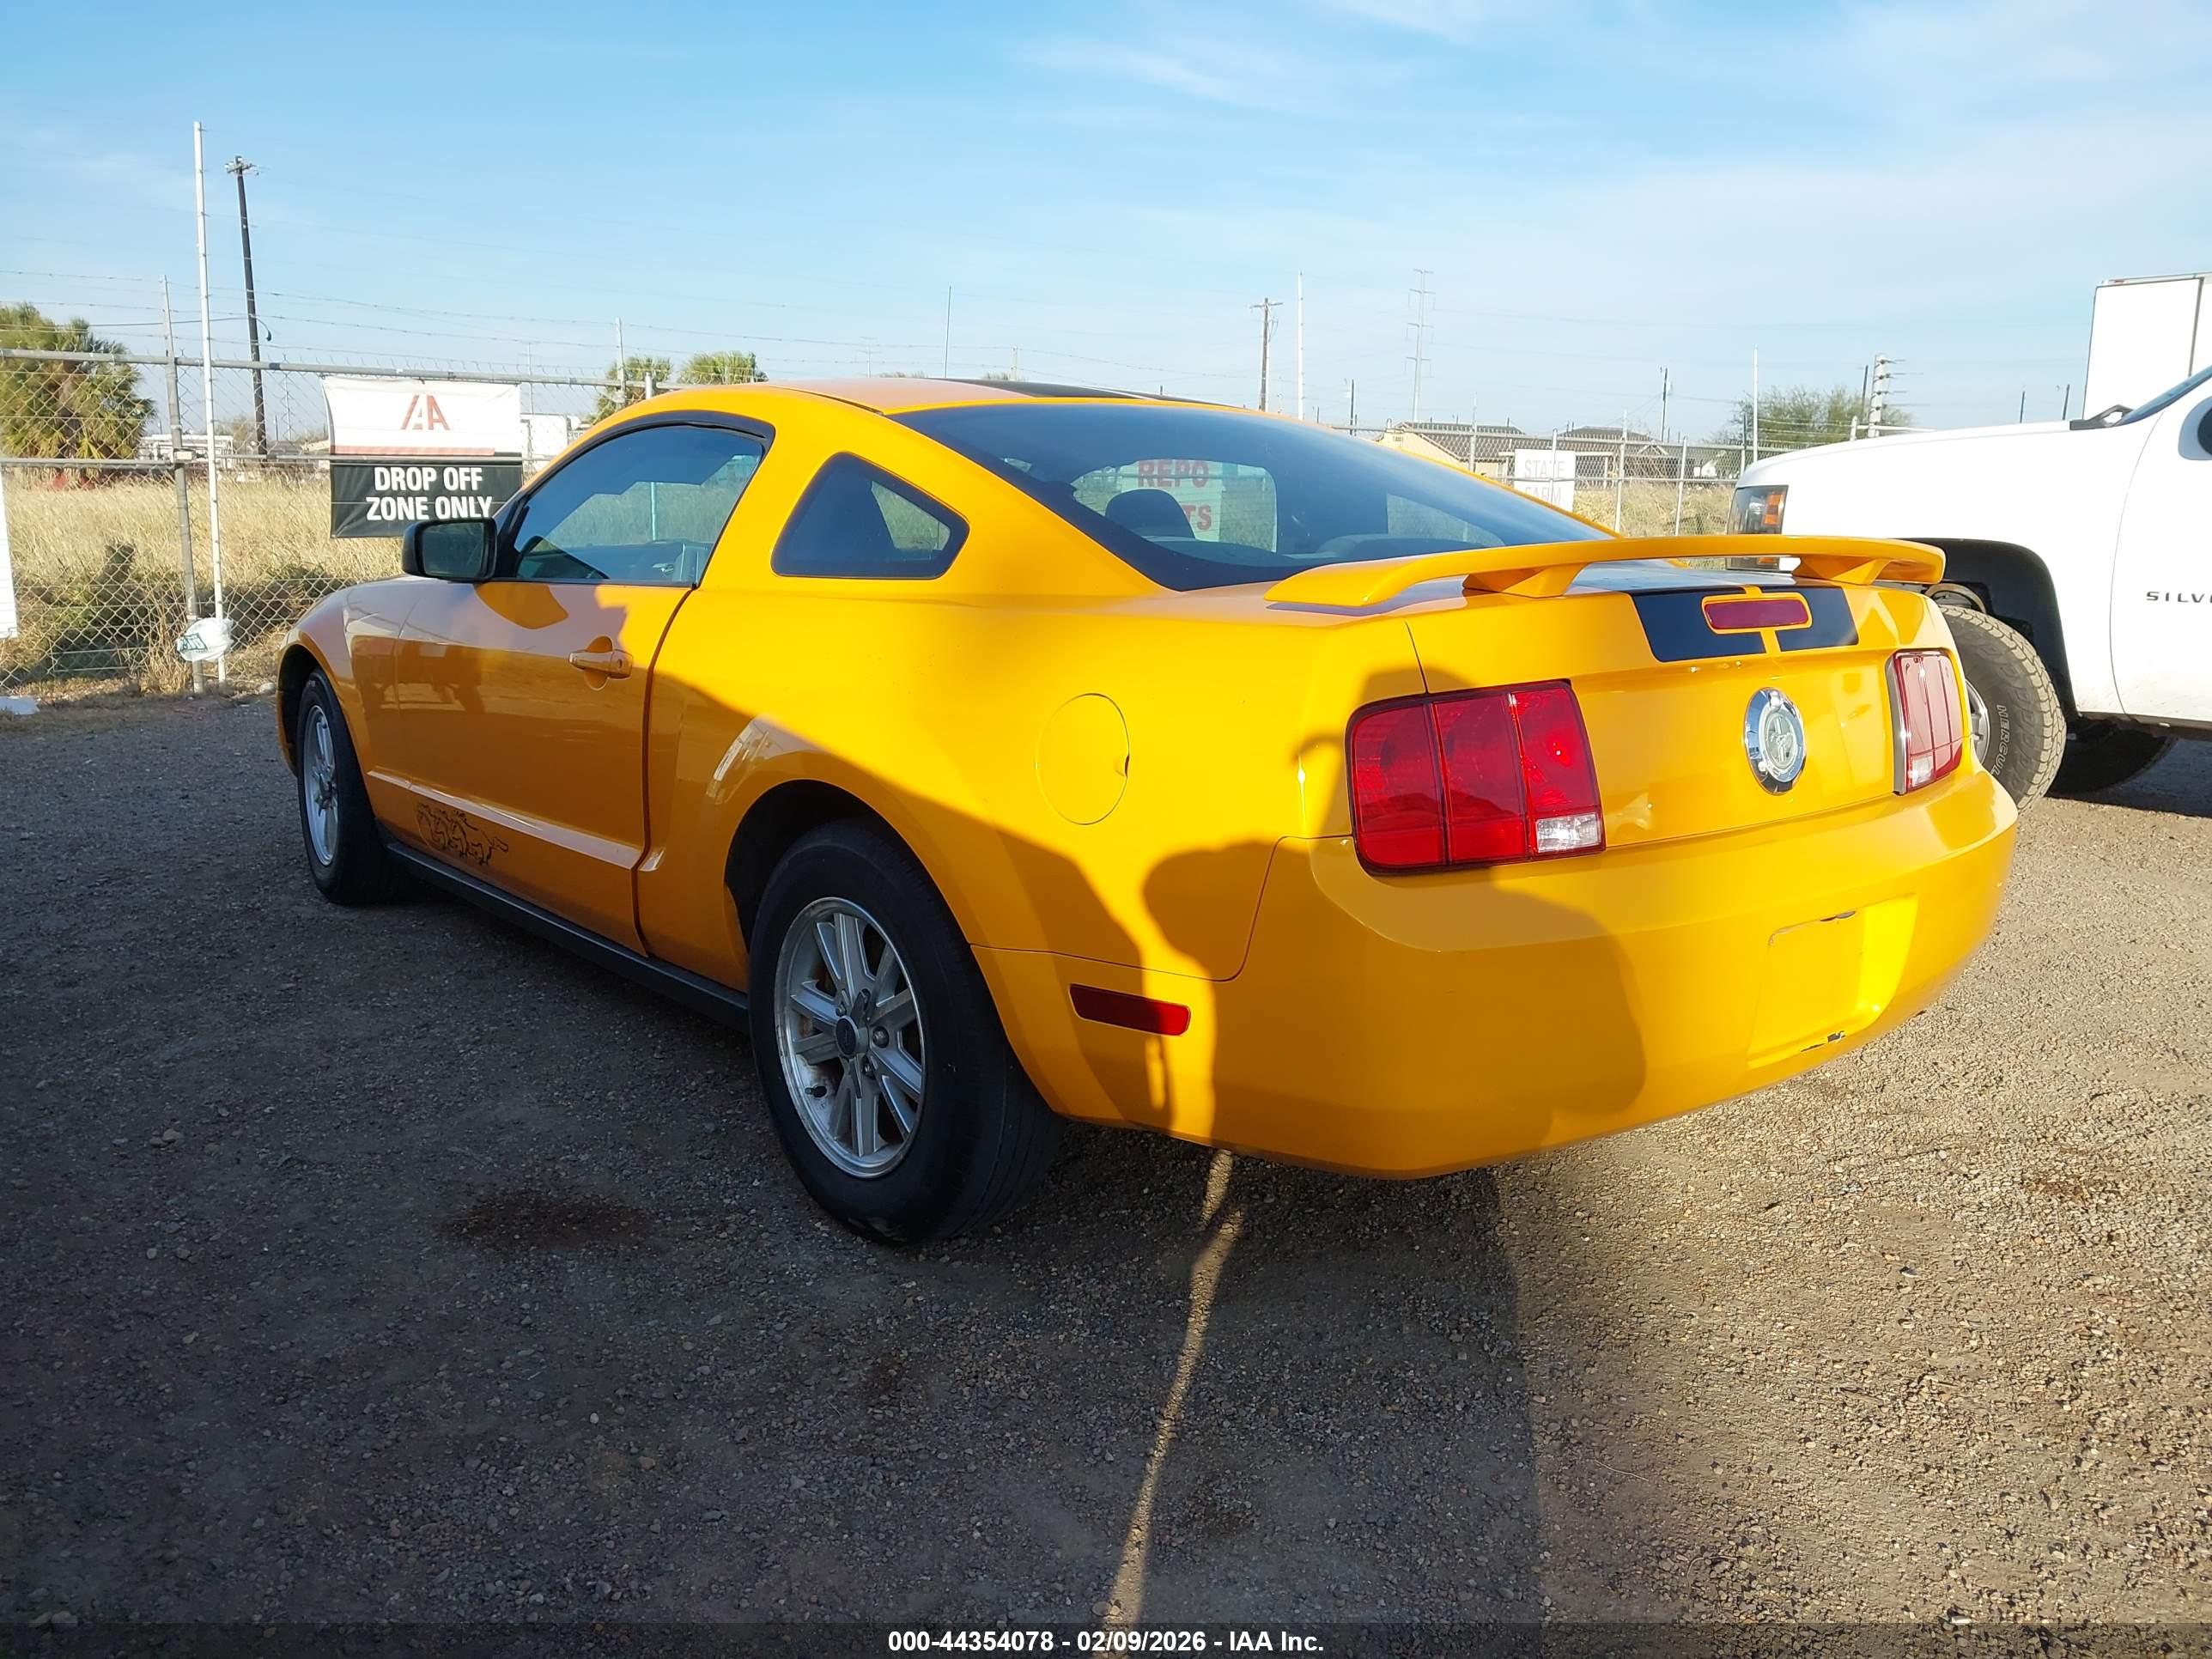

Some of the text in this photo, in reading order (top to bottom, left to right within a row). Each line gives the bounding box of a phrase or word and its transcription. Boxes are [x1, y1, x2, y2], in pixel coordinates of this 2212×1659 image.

[374, 467, 483, 491] DROP OFF
[1138, 459, 1209, 488] REPO
[365, 496, 493, 521] ZONE ONLY
[2146, 591, 2212, 604] SILV
